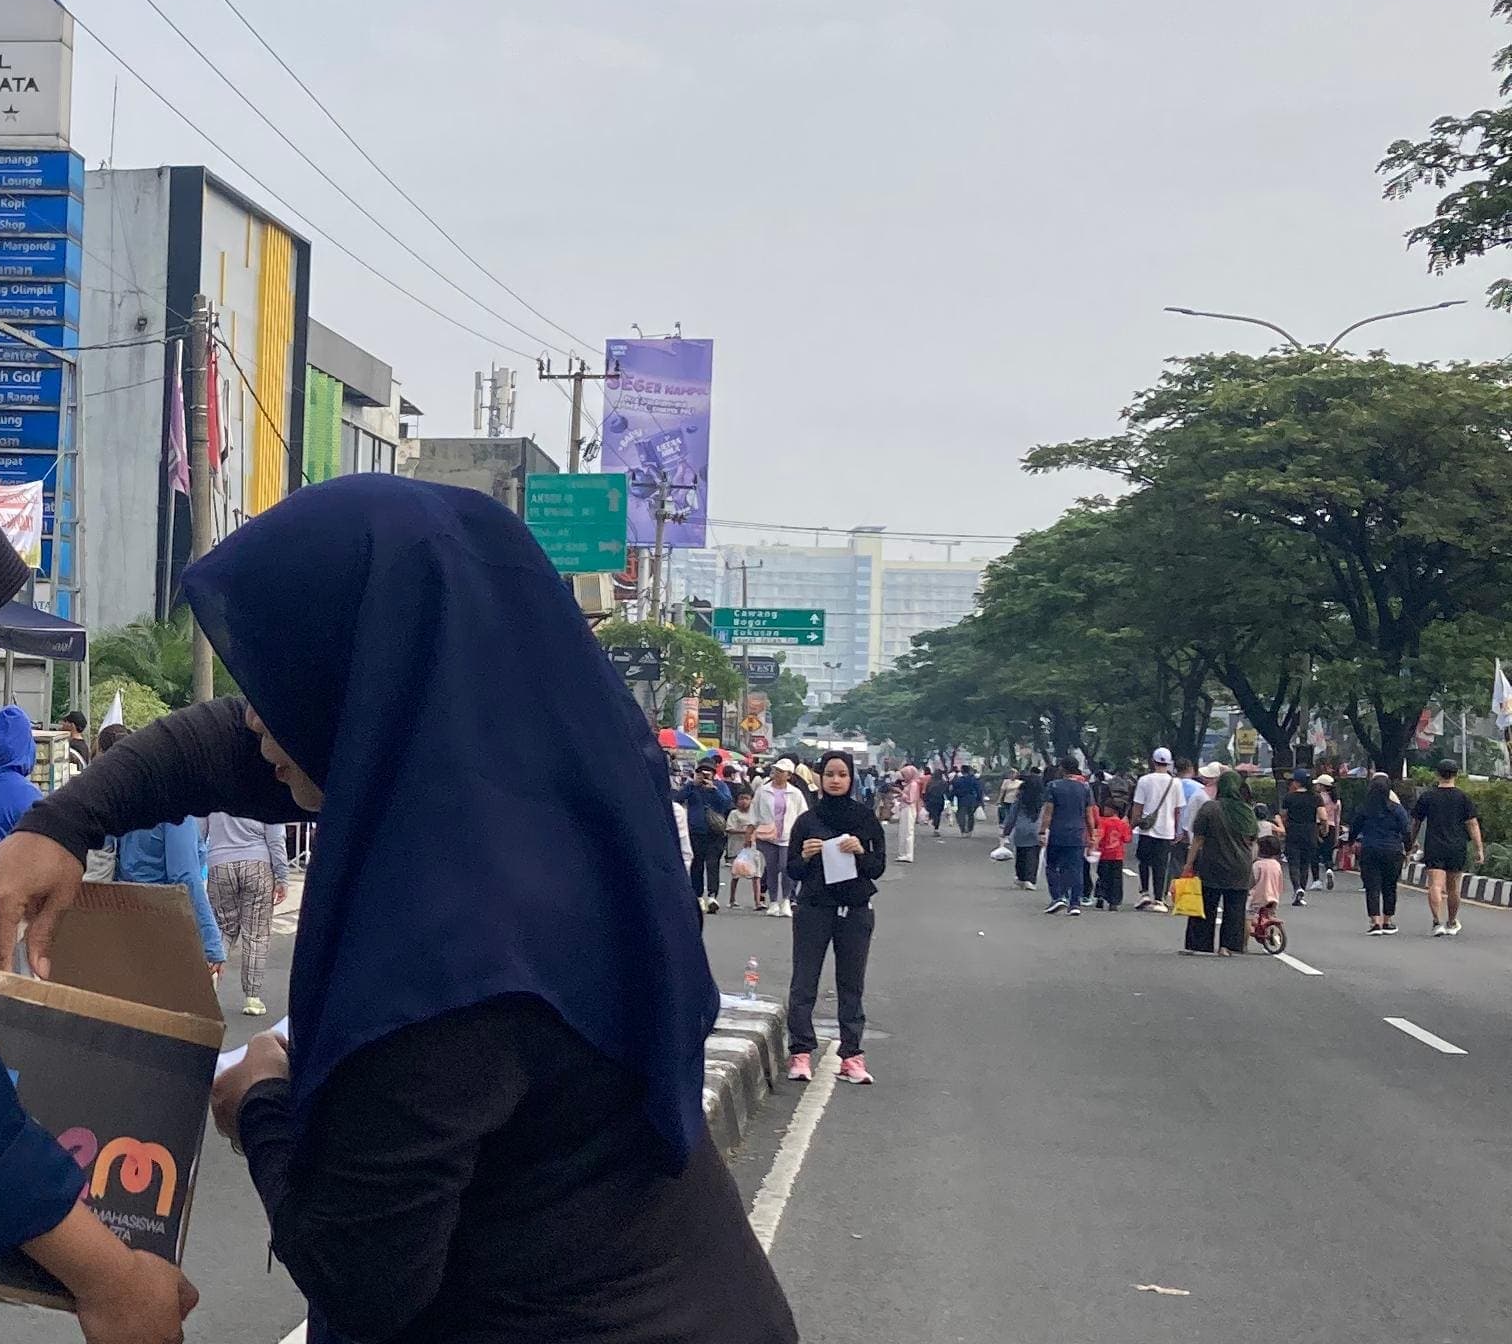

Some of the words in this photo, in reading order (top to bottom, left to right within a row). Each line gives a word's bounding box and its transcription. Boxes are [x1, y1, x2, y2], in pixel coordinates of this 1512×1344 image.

[1, 176, 43, 187] Lounge
[0, 198, 25, 209] Kopi
[11, 285, 54, 297] Olimpik
[32, 307, 57, 316] Pool
[12, 370, 42, 384] Golf
[7, 393, 40, 404] Range
[733, 609, 778, 619] Cawang
[733, 618, 767, 627] Bogor
